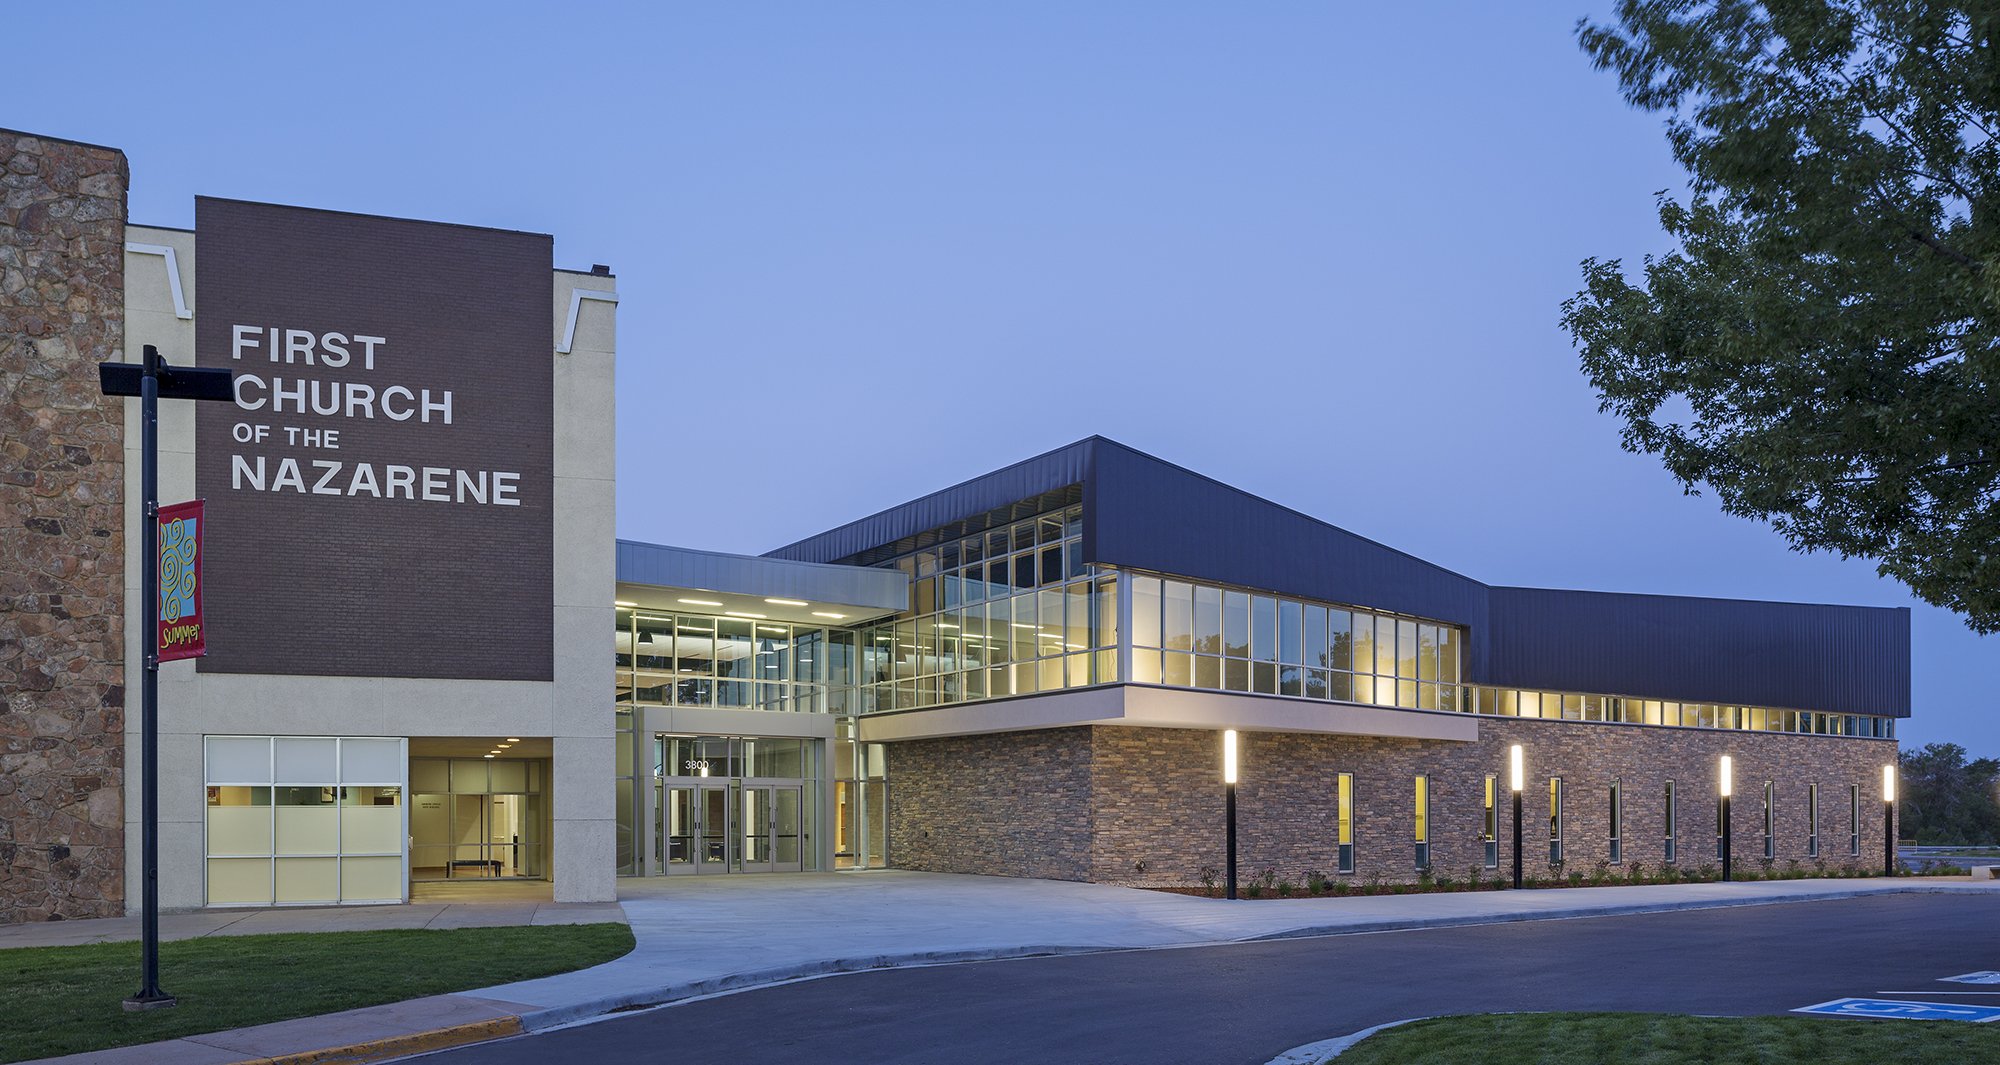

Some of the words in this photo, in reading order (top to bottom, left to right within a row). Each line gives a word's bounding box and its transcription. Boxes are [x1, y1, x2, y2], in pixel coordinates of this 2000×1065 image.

[232, 324, 386, 370] FIRST
[233, 373, 453, 424] CHURCH
[232, 422, 270, 444] OF
[284, 426, 340, 449] THE
[232, 454, 521, 506] NAZARENE
[685, 760, 709, 770] 3800
